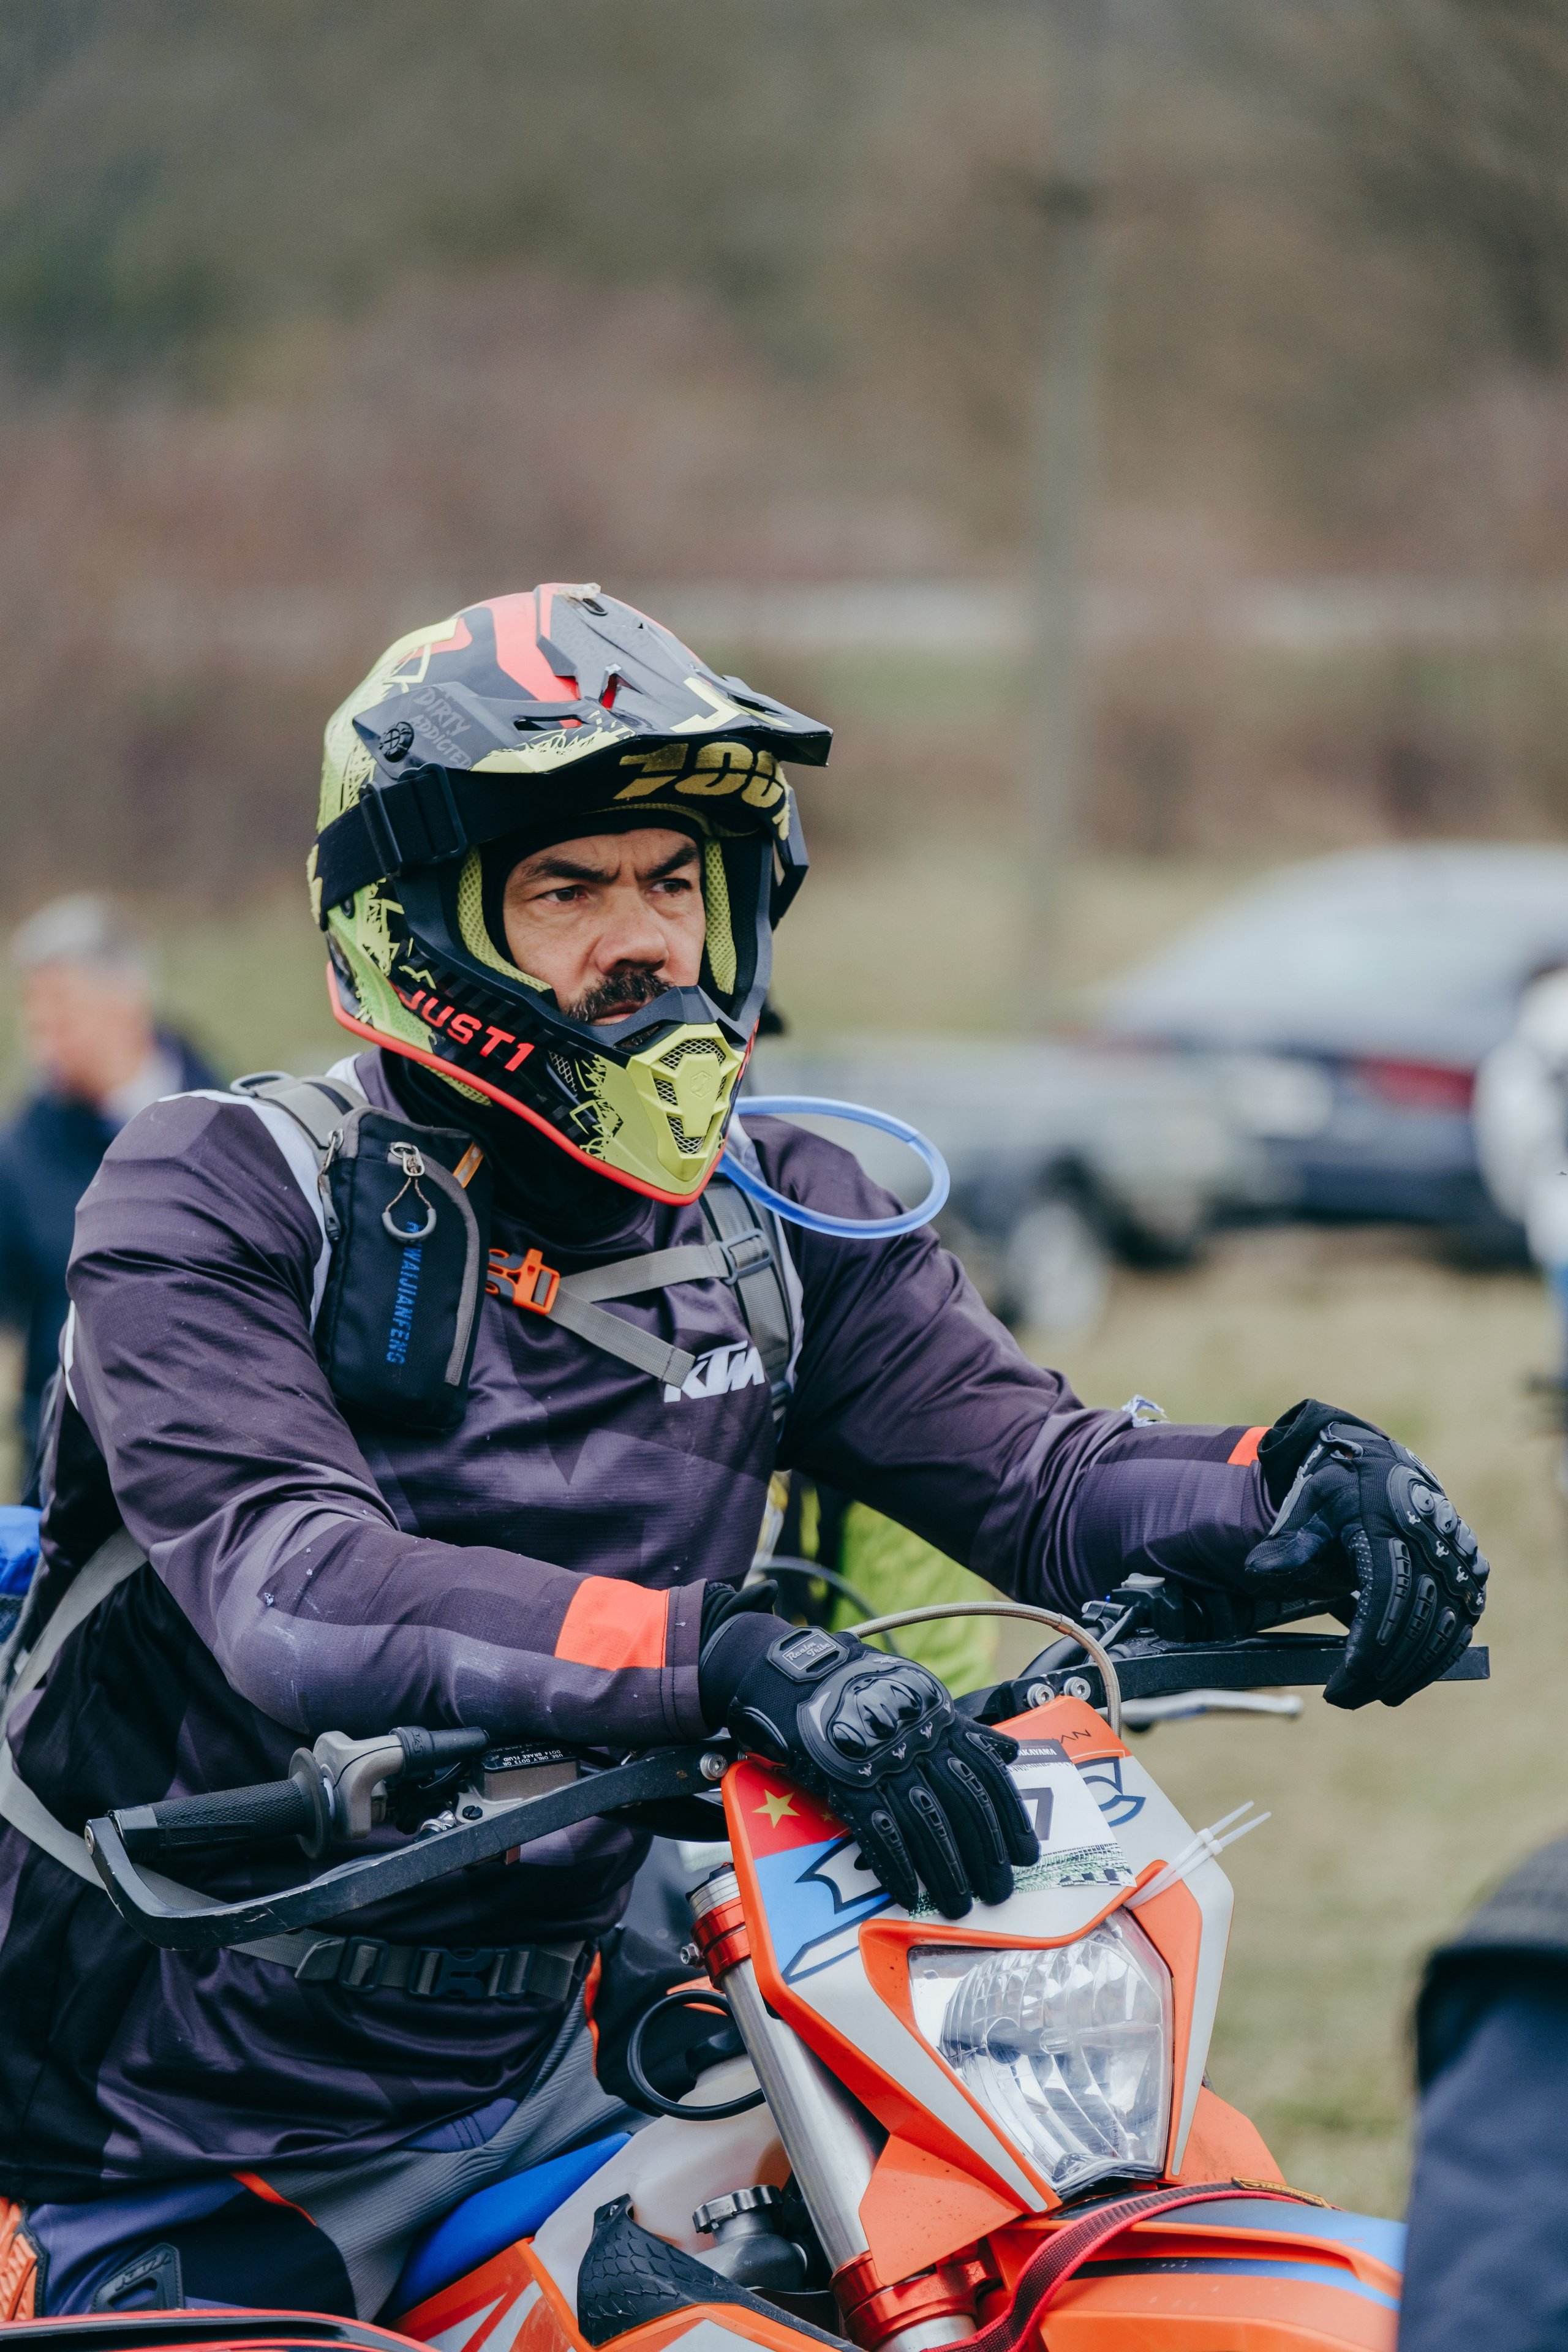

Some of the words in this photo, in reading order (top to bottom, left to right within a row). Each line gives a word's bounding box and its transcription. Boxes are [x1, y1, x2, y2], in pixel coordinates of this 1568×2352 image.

[413, 687, 472, 737] DIRTY
[398, 989, 535, 1072] JUST1
[663, 1340, 766, 1403] KTM
